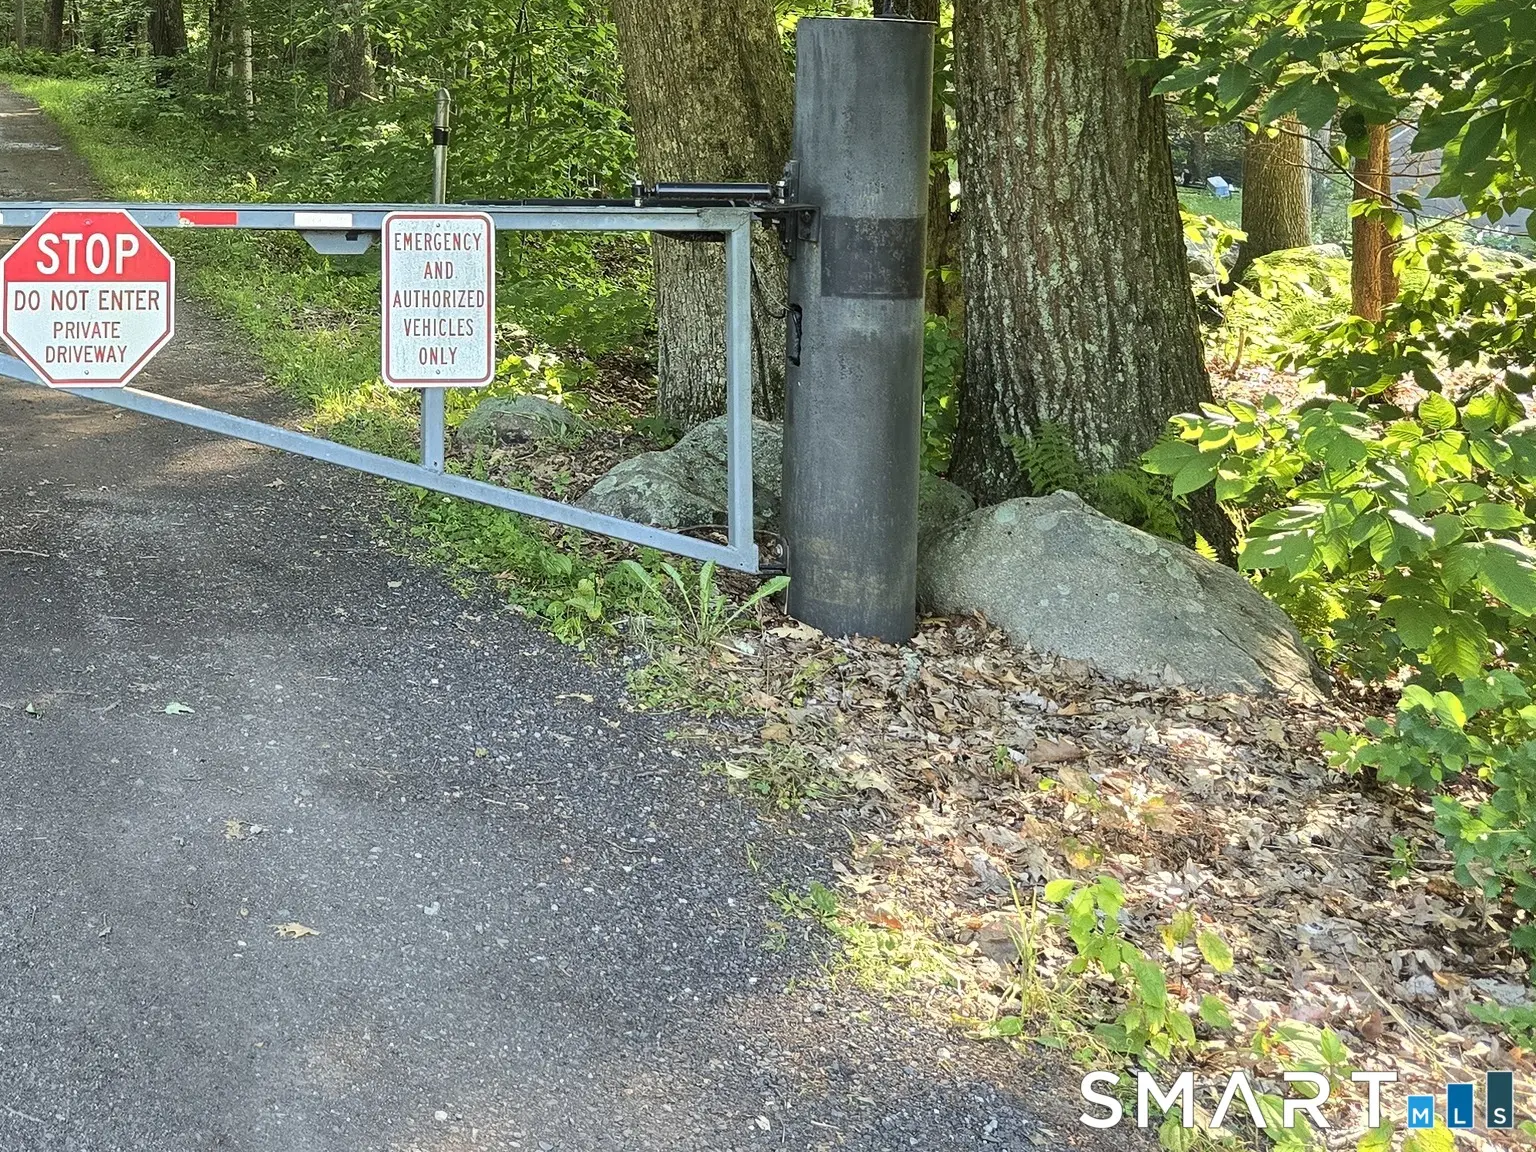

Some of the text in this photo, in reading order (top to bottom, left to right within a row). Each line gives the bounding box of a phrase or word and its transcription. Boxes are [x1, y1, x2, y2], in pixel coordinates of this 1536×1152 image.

[394, 232, 482, 251] EMERGENCY
[36, 232, 140, 275] STOP
[423, 261, 454, 280] AND
[14, 289, 160, 311] DO NOT ENTER
[392, 290, 485, 308] AUTHORIZED
[53, 321, 121, 339] PRIVATE
[403, 318, 474, 337] VEHICLES
[45, 345, 128, 363] DRIVEWAY
[419, 347, 458, 365] ONLY
